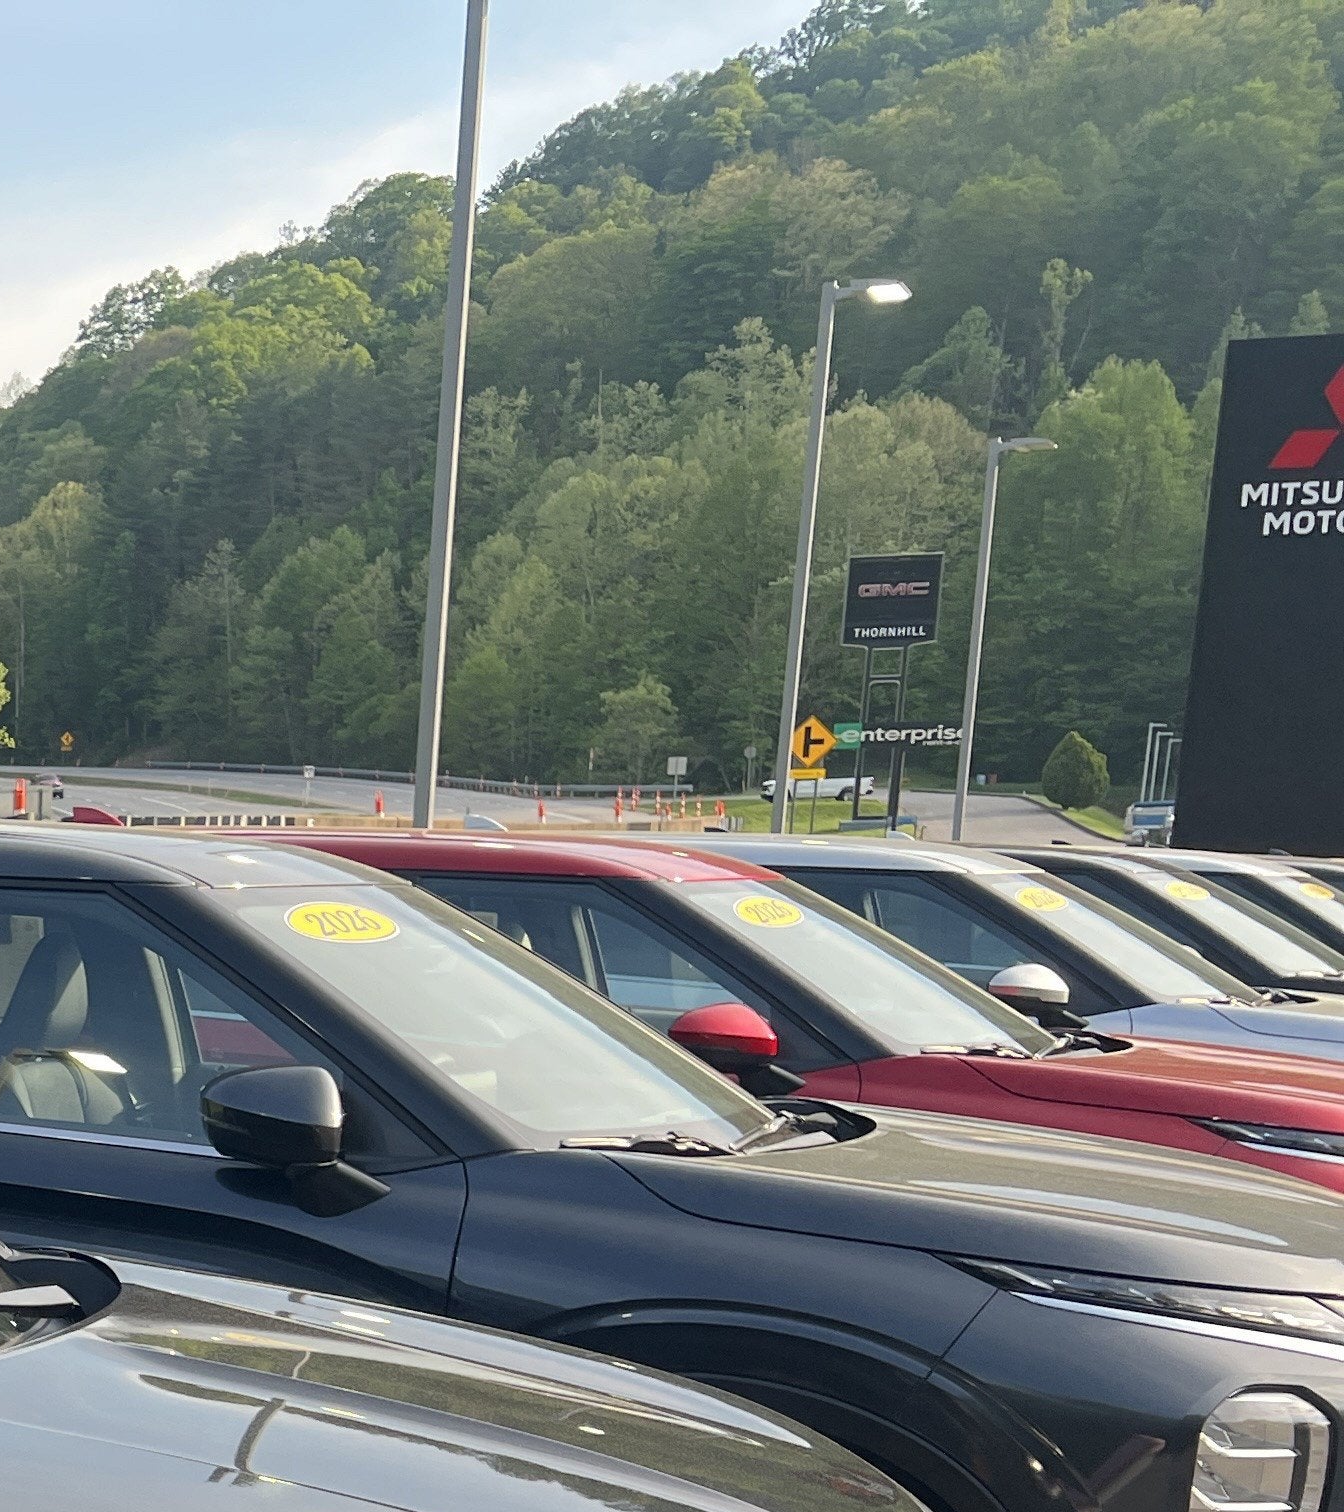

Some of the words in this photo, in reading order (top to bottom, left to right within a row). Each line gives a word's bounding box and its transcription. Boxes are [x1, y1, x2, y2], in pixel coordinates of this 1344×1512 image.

[1240, 480, 1344, 508] MITSU
[858, 581, 930, 598] GMC
[853, 625, 926, 638] THORNHILL
[304, 908, 382, 937] 2026
